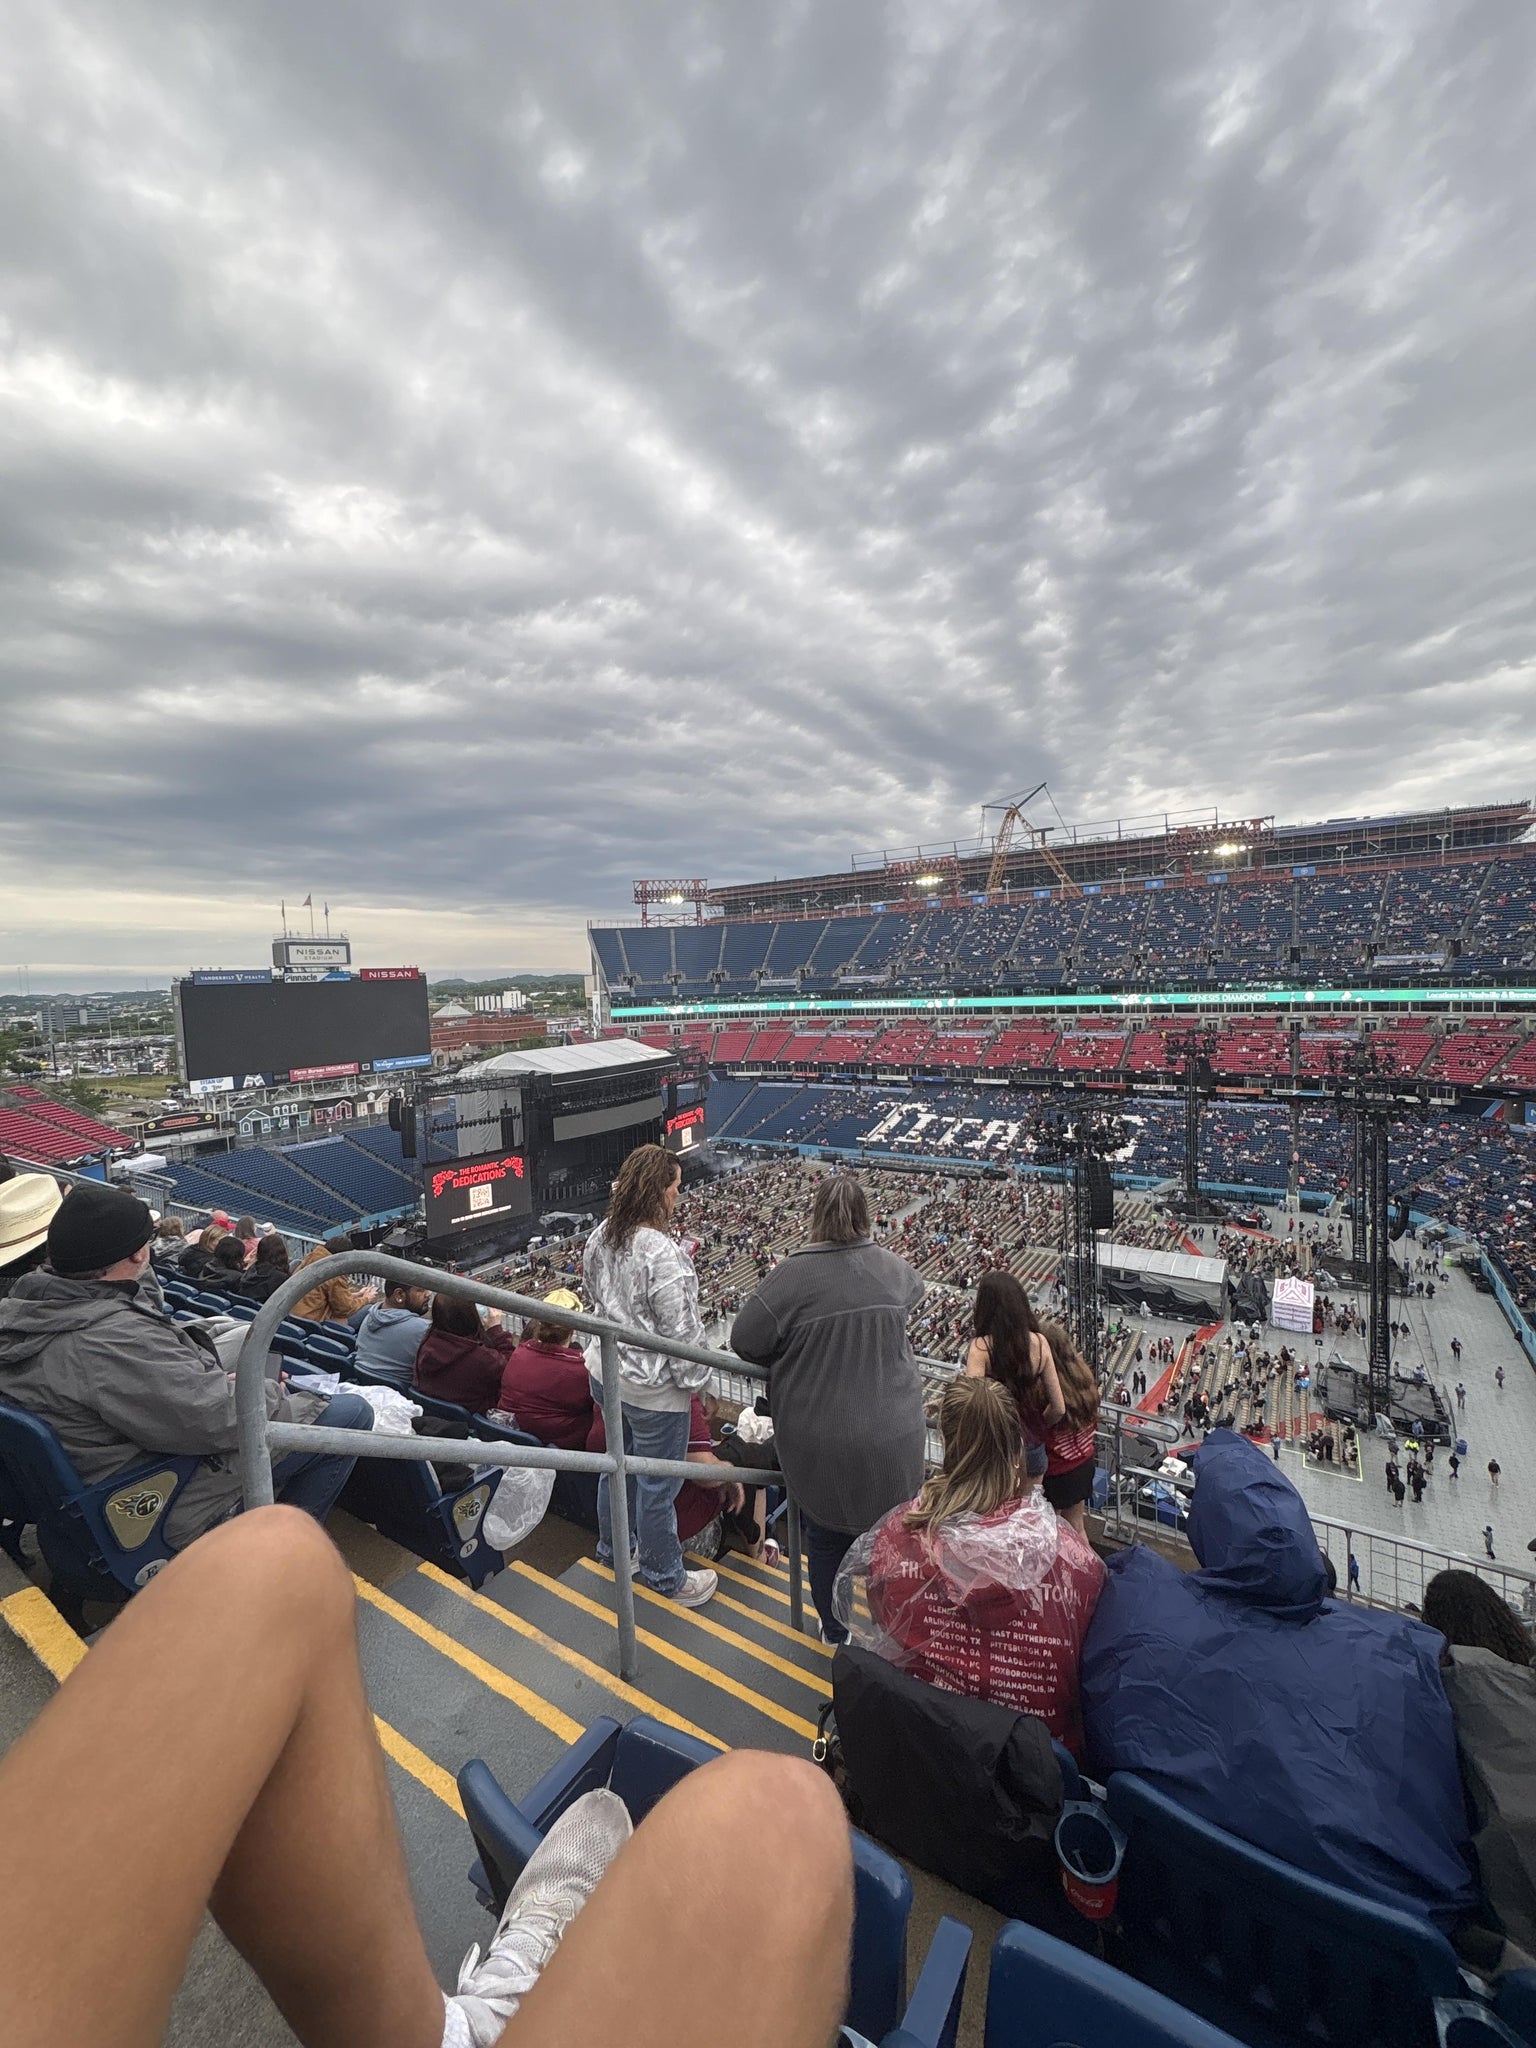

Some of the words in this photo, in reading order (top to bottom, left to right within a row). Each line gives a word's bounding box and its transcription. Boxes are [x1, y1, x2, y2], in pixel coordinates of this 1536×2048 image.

[285, 974, 317, 982] Pinnacle
[1222, 993, 1267, 1001] DIAMONDS
[1426, 991, 1460, 999] Locations
[1468, 991, 1500, 999] Nashville
[325, 1063, 355, 1071] INSURANCE
[459, 1167, 471, 1175] THE
[471, 1161, 499, 1172] ROMANTIC
[453, 1168, 506, 1188] DEDICATIONS
[465, 1543, 473, 1553] D
[146, 1565, 159, 1580] E
[924, 1591, 938, 1601] LAS
[1027, 1622, 1038, 1630] UK
[970, 1637, 981, 1645] TX
[969, 1648, 981, 1657] GA
[1042, 1649, 1053, 1658] PA
[969, 1660, 981, 1669] NC
[1049, 1662, 1058, 1670] PA
[968, 1673, 980, 1681] MD
[1046, 1674, 1058, 1683] MA
[969, 1684, 980, 1692] TN
[1047, 1685, 1056, 1693] IN
[1020, 1694, 1030, 1703] FL
[1047, 1708, 1056, 1717] LA
